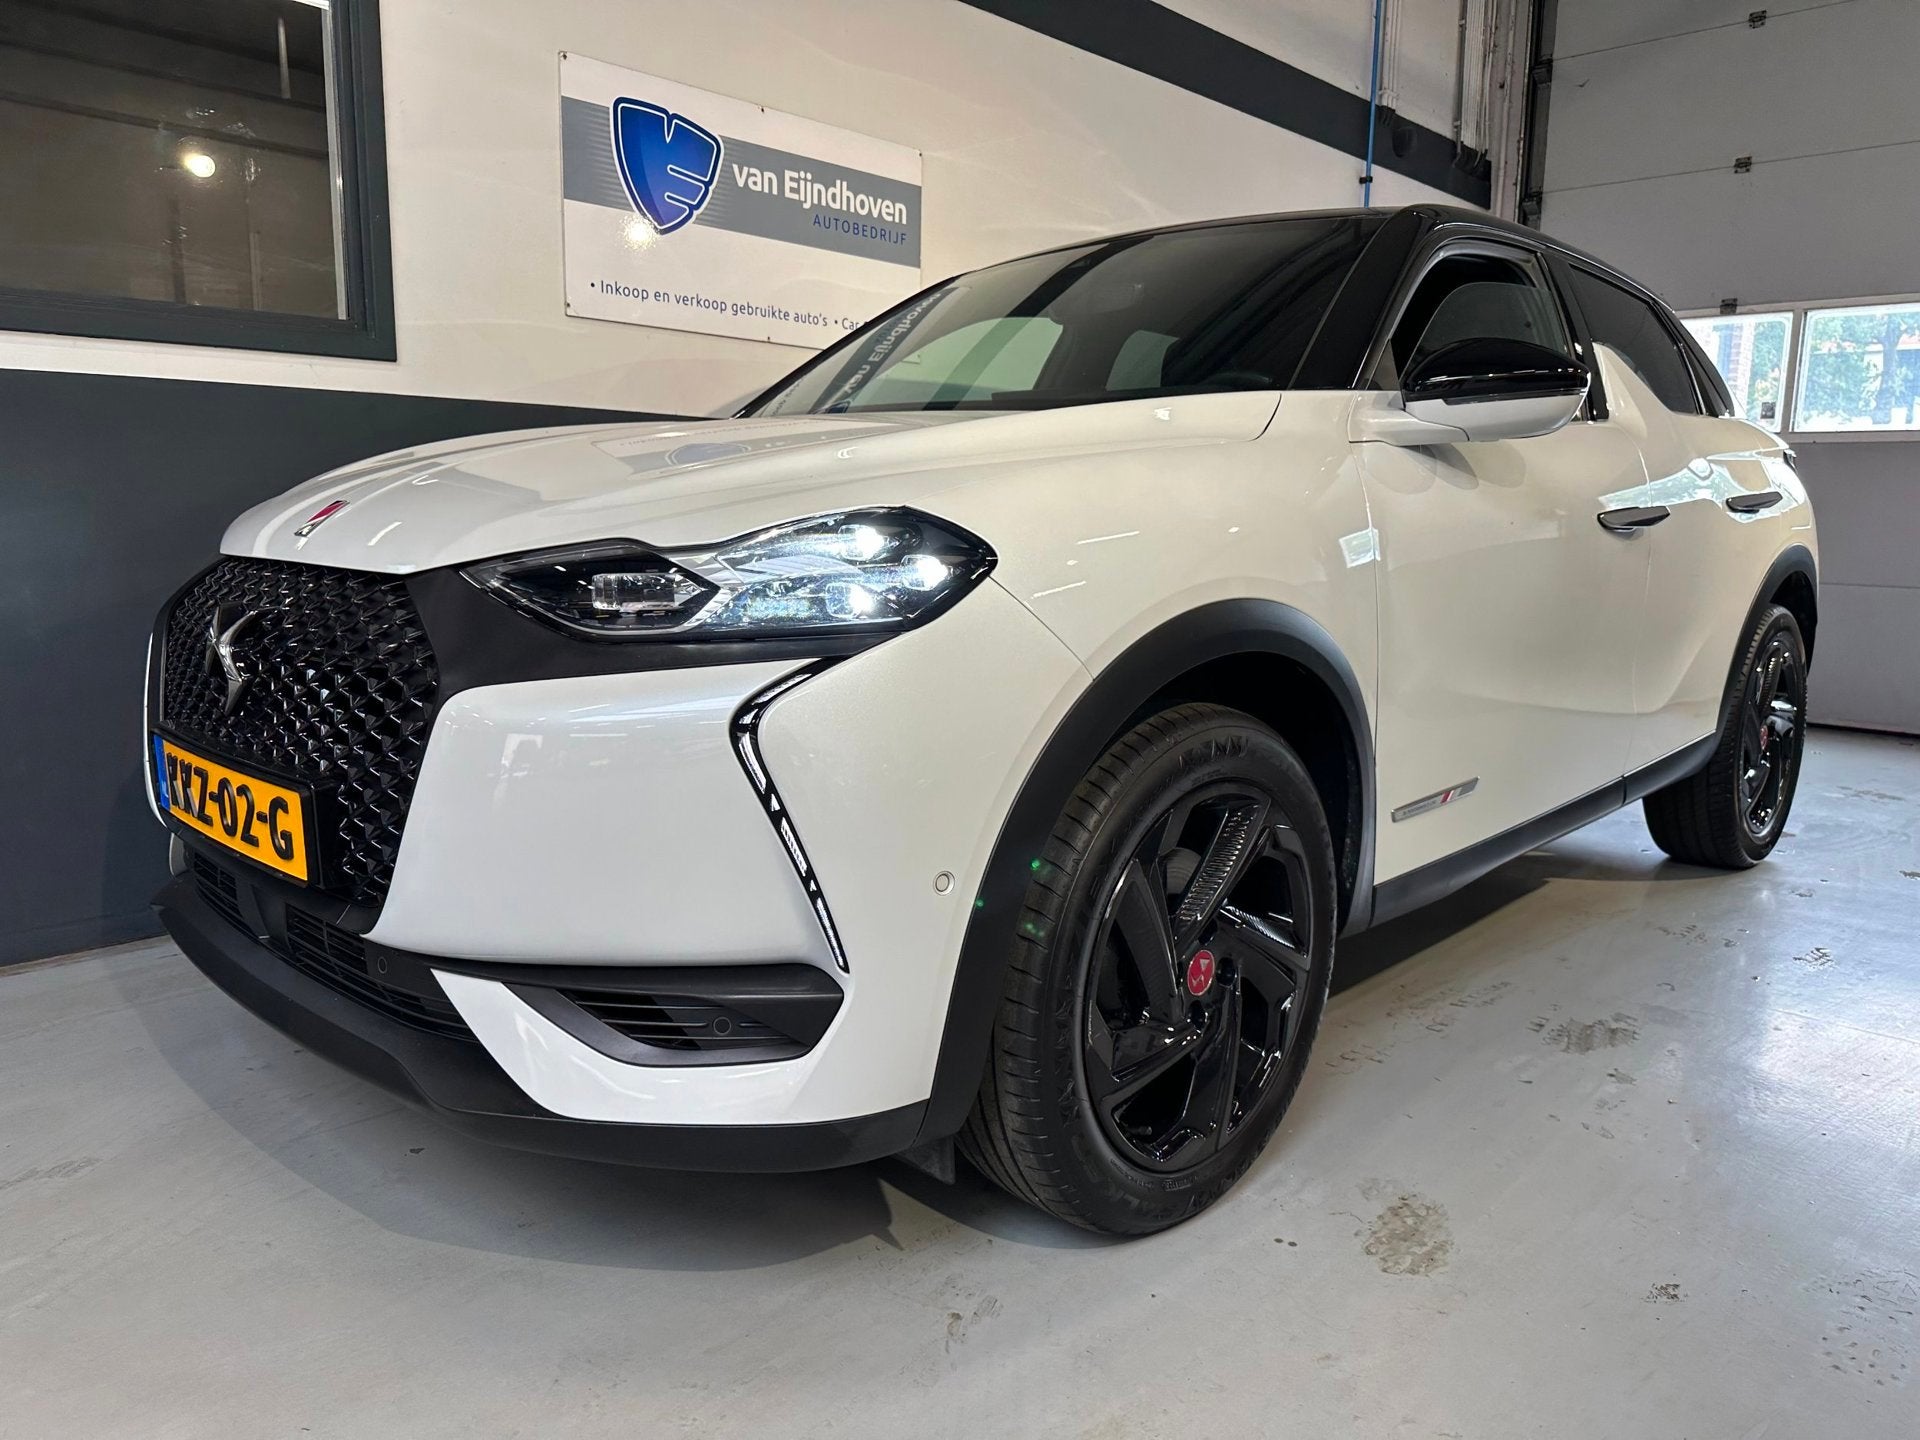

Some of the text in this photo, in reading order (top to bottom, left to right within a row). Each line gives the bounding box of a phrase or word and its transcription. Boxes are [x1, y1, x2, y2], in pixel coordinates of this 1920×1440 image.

[732, 163, 907, 225] van Eijndhoven
[813, 213, 907, 246] AUTOBEDRIJF
[600, 280, 649, 302] Inkoop
[653, 290, 670, 303] en
[674, 293, 727, 314] verkoop
[731, 301, 790, 322] gebruikte
[793, 312, 828, 327] auto's
[841, 317, 860, 331] Car
